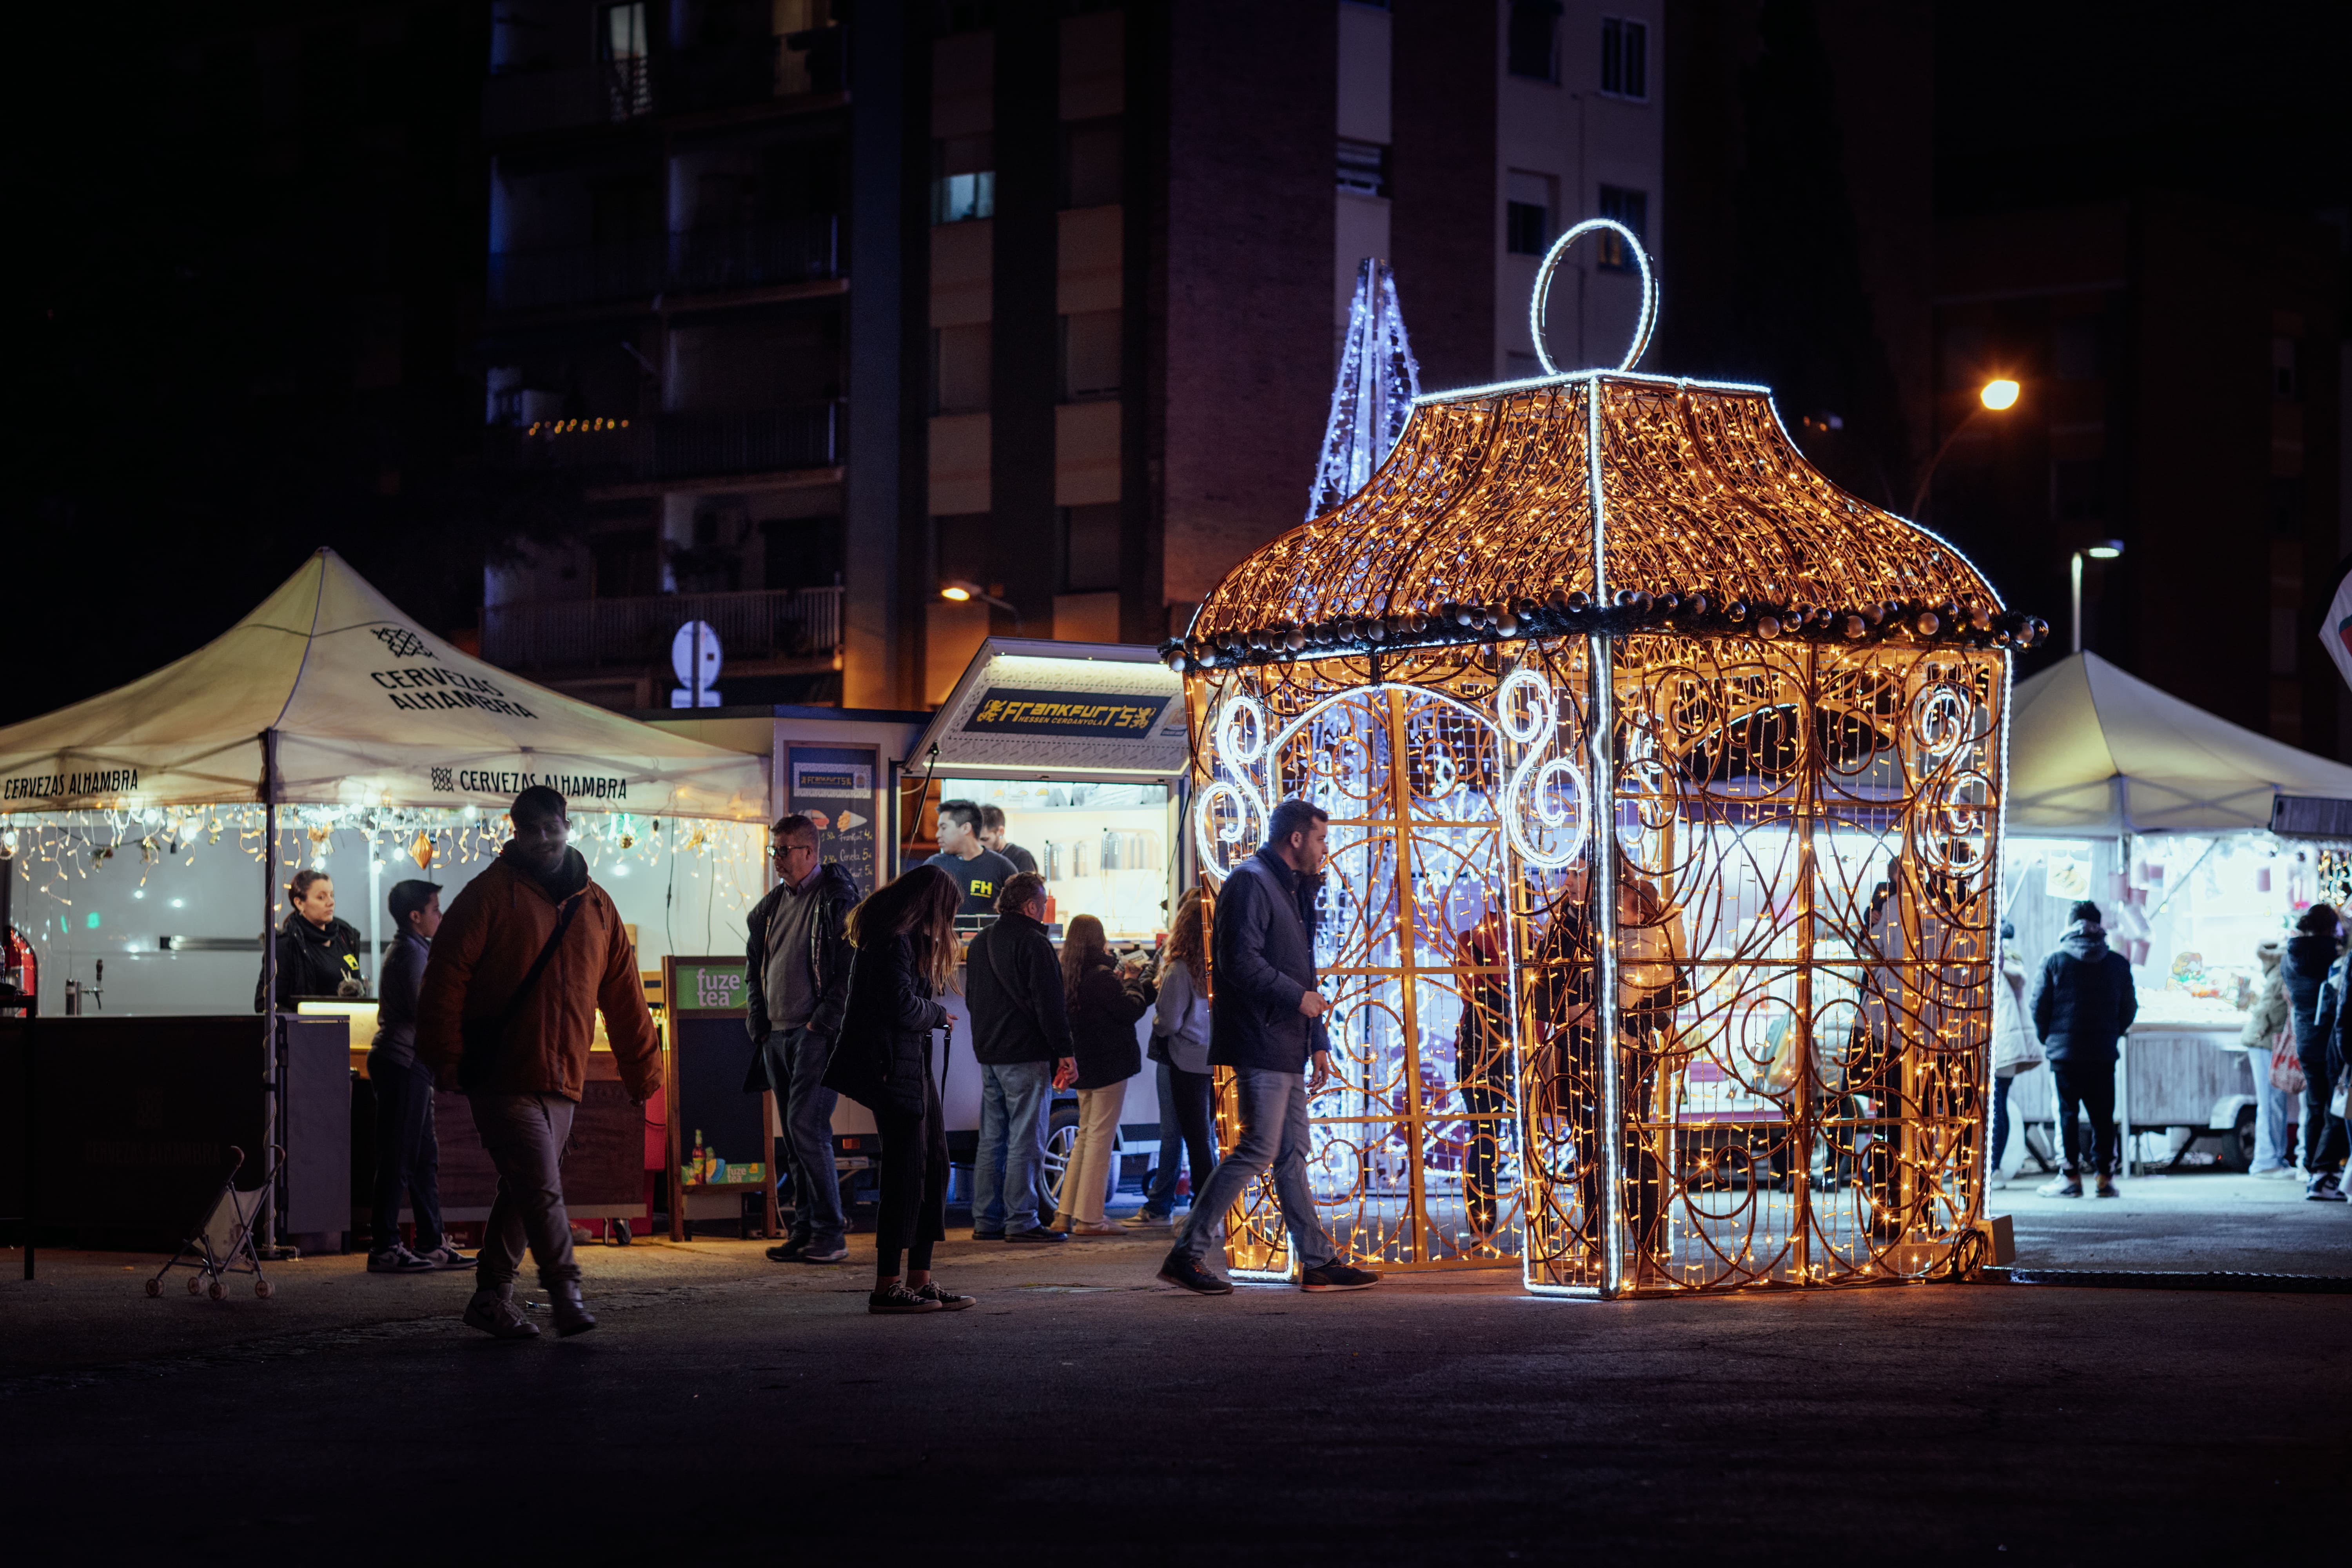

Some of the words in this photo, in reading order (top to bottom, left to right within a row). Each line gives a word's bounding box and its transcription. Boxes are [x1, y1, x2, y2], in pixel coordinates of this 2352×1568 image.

[370, 668, 505, 697] CERVEZAS
[388, 690, 539, 719] ALHAMBRA
[4, 773, 65, 800] CERVEZAS
[68, 769, 138, 795] ALHAMBRA
[971, 880, 993, 895] FH
[697, 968, 740, 991] fuze
[697, 989, 730, 1007] tea
[727, 1165, 747, 1176] fuze
[727, 1174, 742, 1183] tea
